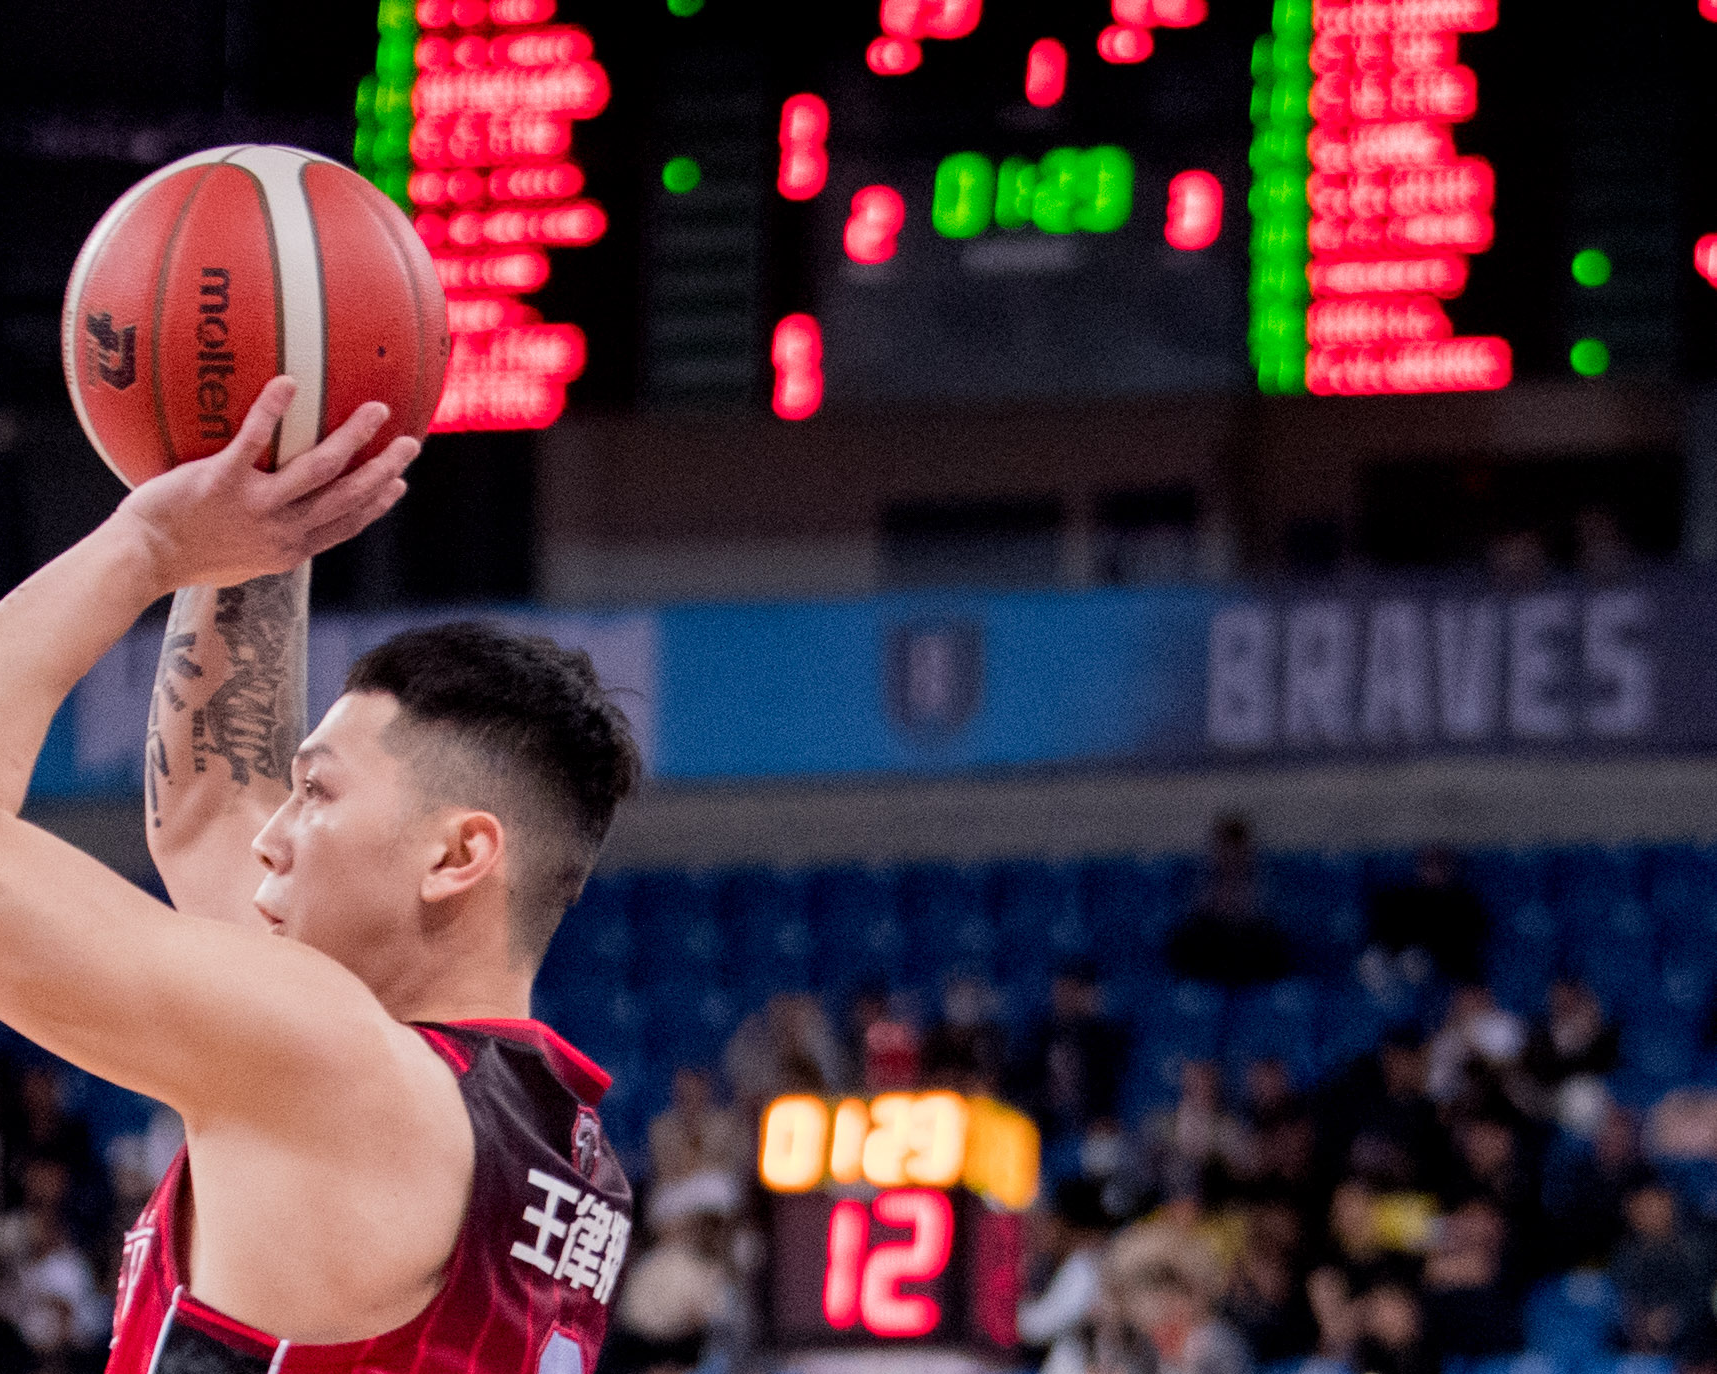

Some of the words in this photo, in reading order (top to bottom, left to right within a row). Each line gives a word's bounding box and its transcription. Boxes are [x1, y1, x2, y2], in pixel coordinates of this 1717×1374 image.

[195, 267, 235, 439] molten
[1206, 588, 1654, 748] BRAVES
[823, 1187, 954, 1338] 12
